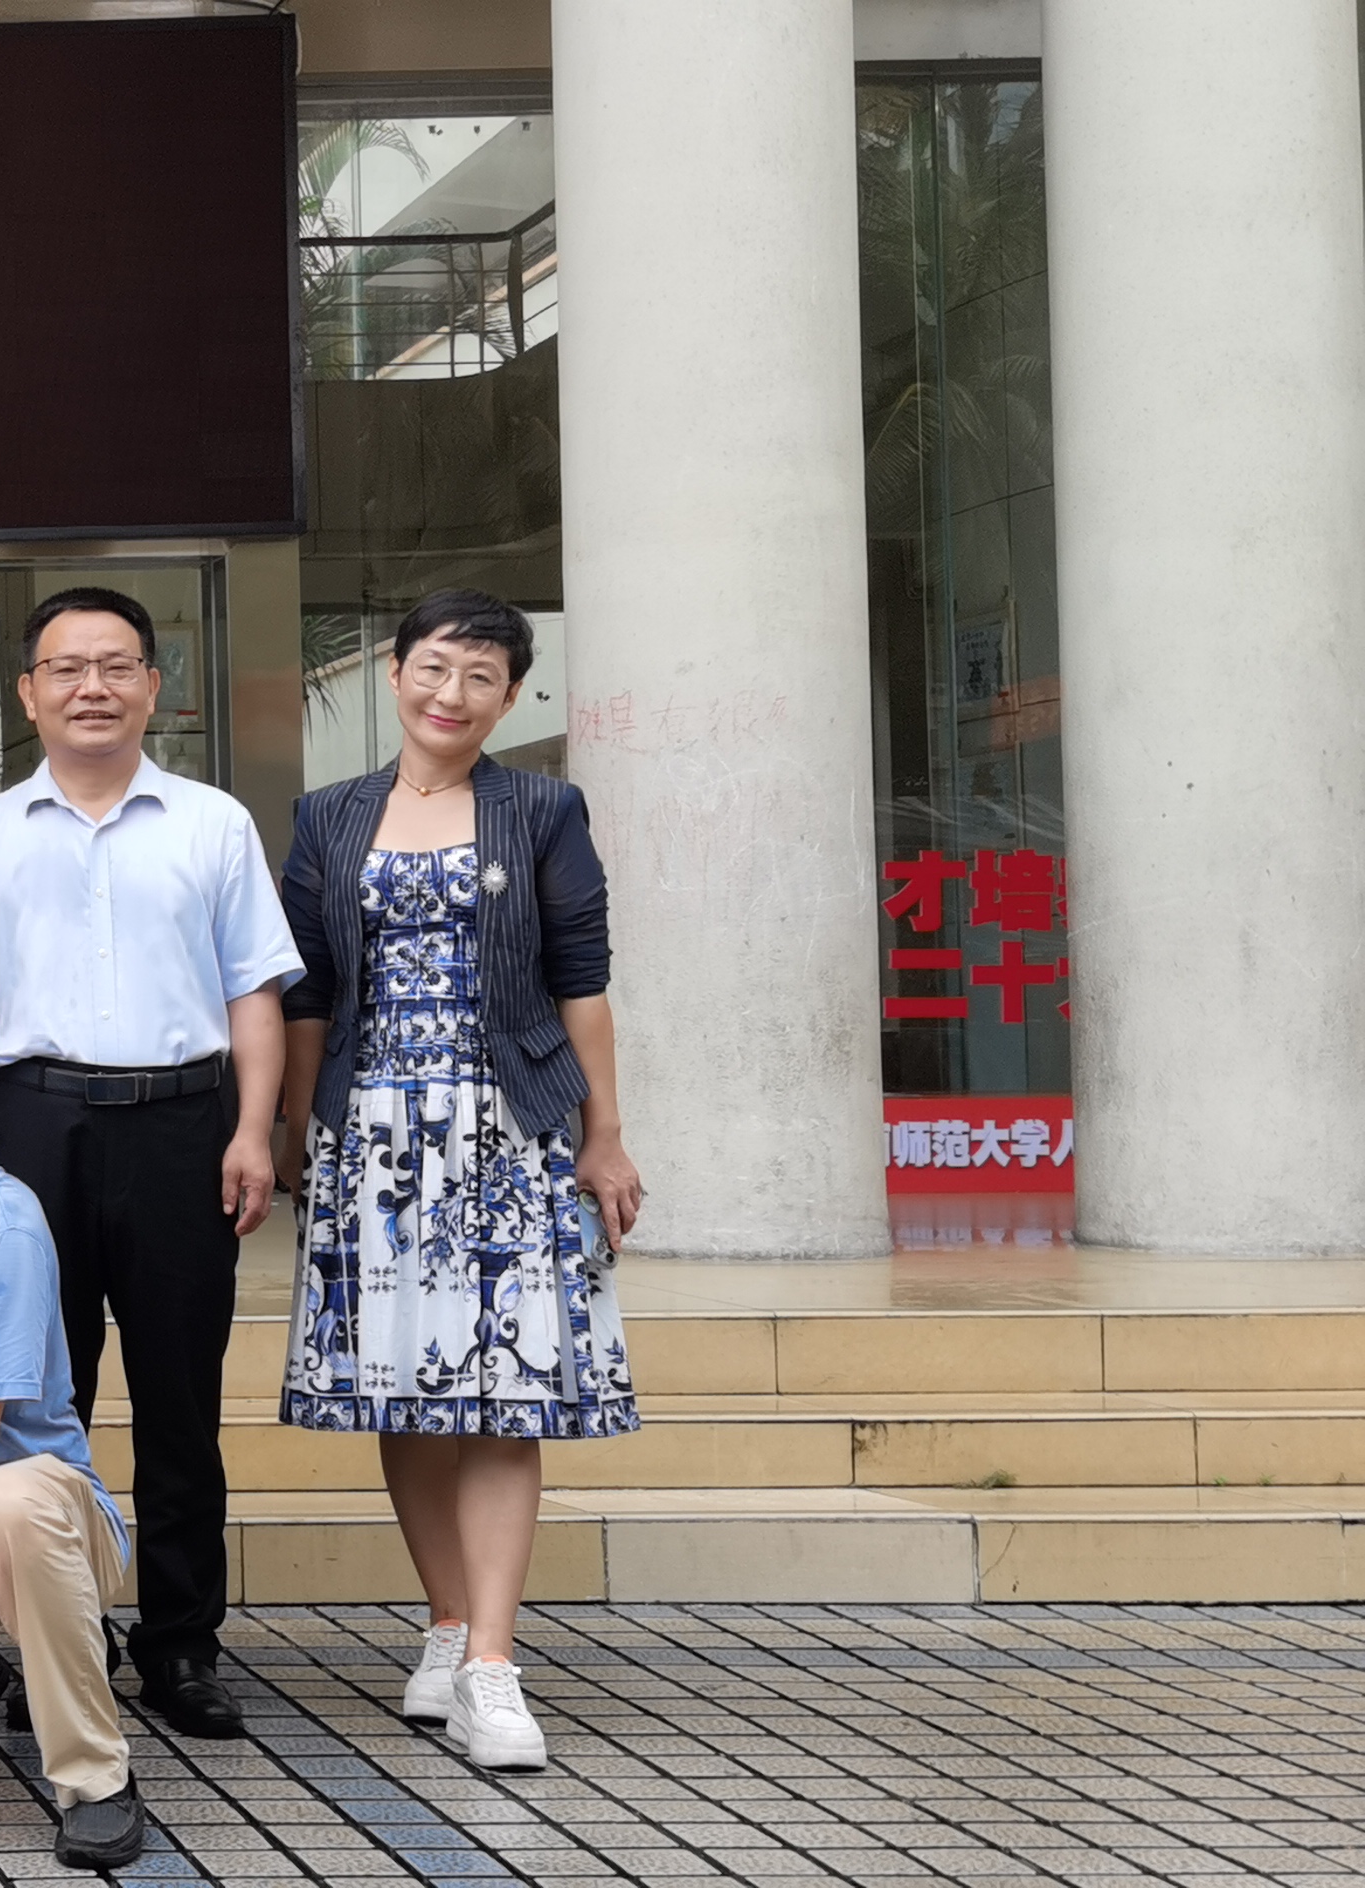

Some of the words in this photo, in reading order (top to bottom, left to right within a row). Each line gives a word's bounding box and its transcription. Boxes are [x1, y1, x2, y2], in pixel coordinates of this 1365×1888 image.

[882, 848, 1067, 932] 才培
[884, 941, 1070, 1023] 二十
[884, 1119, 1074, 1168] 师范大学人
